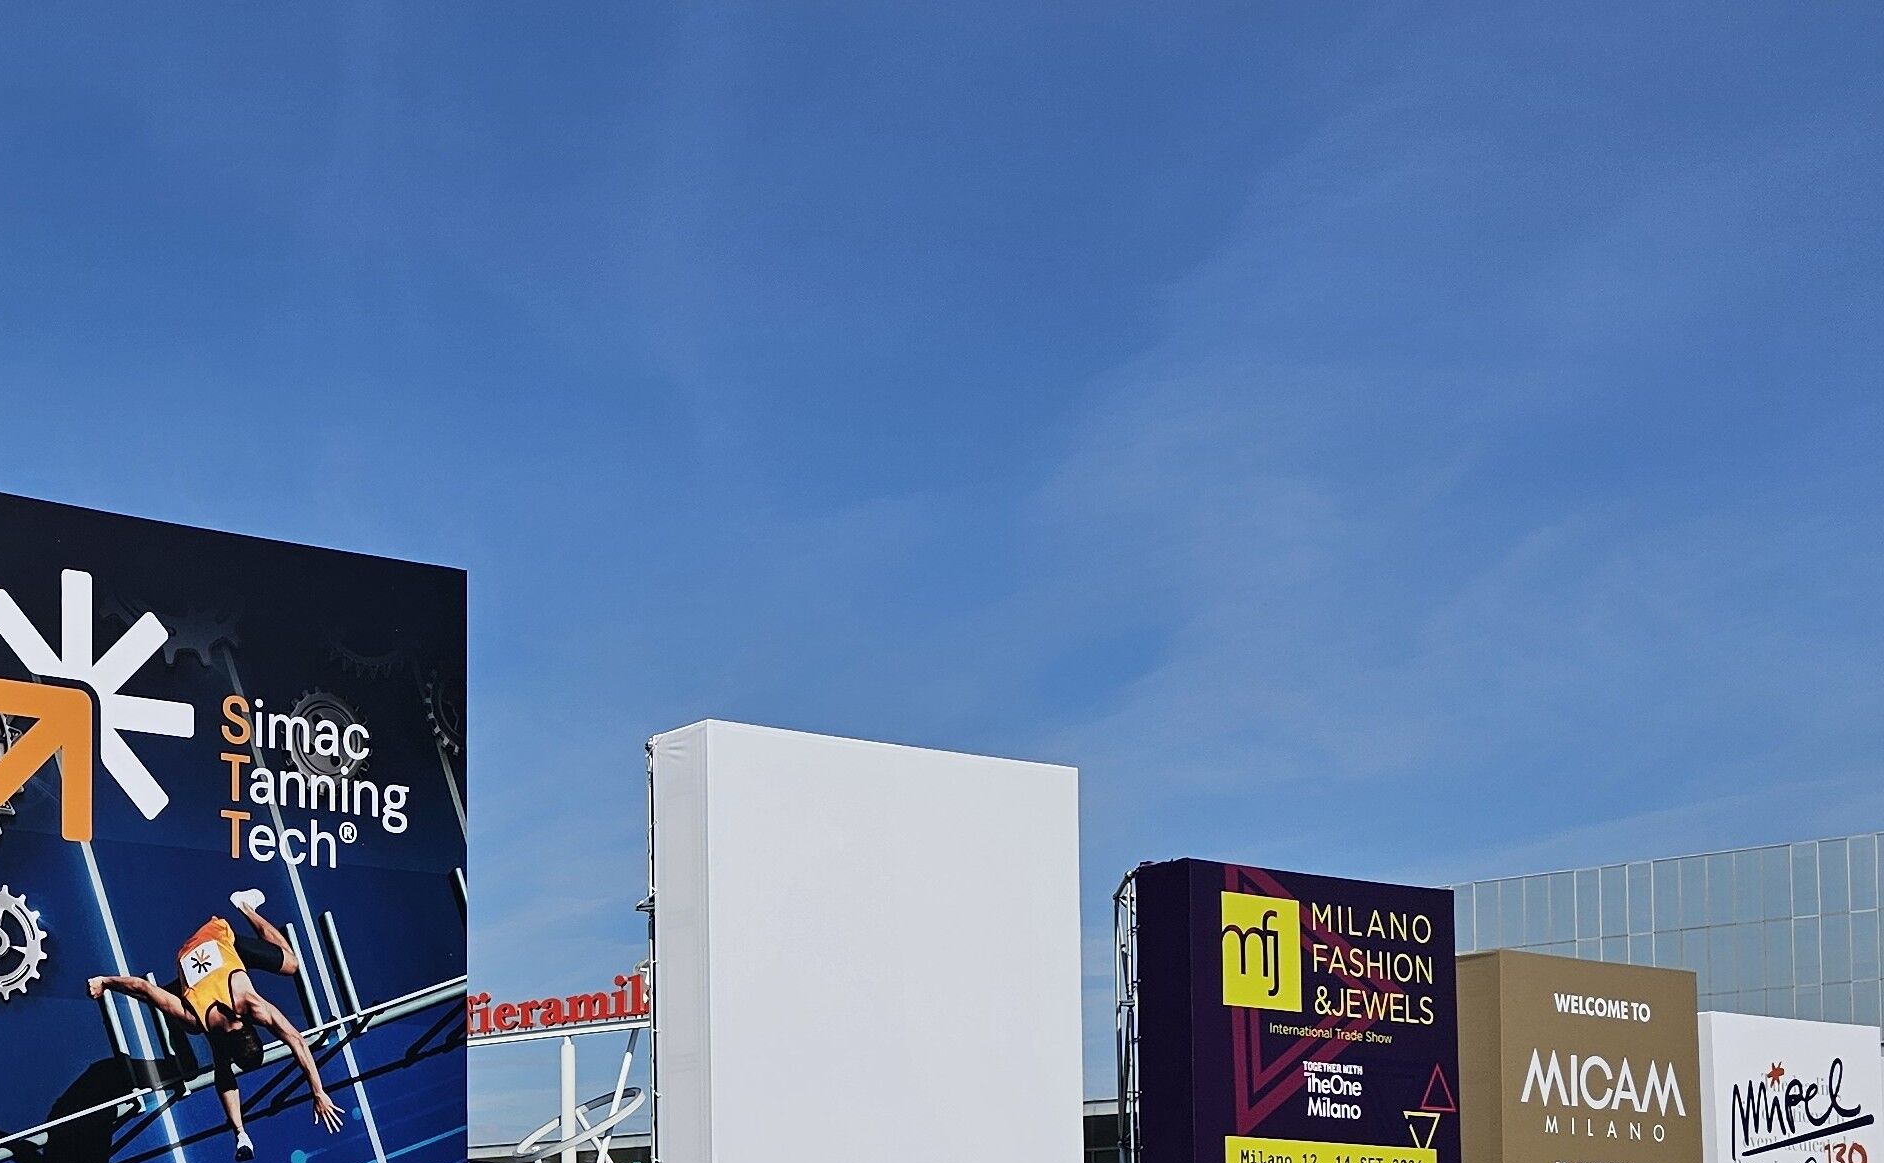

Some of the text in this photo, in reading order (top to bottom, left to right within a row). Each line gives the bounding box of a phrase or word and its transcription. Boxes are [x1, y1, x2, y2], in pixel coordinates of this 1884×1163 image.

[221, 694, 370, 761] Simac
[221, 752, 410, 834] Tanning
[1312, 902, 1432, 944] MILANO
[1312, 943, 1433, 985] FASHION
[1314, 985, 1434, 1025] &JEWELS
[1553, 992, 1651, 1022] WELCOME TO
[1269, 1022, 1393, 1044] International Trade Show
[1303, 1071, 1363, 1097] TheOne
[1520, 1047, 1686, 1117] MICAM
[1307, 1096, 1362, 1120] Milano
[1544, 1115, 1665, 1143] MILANO
